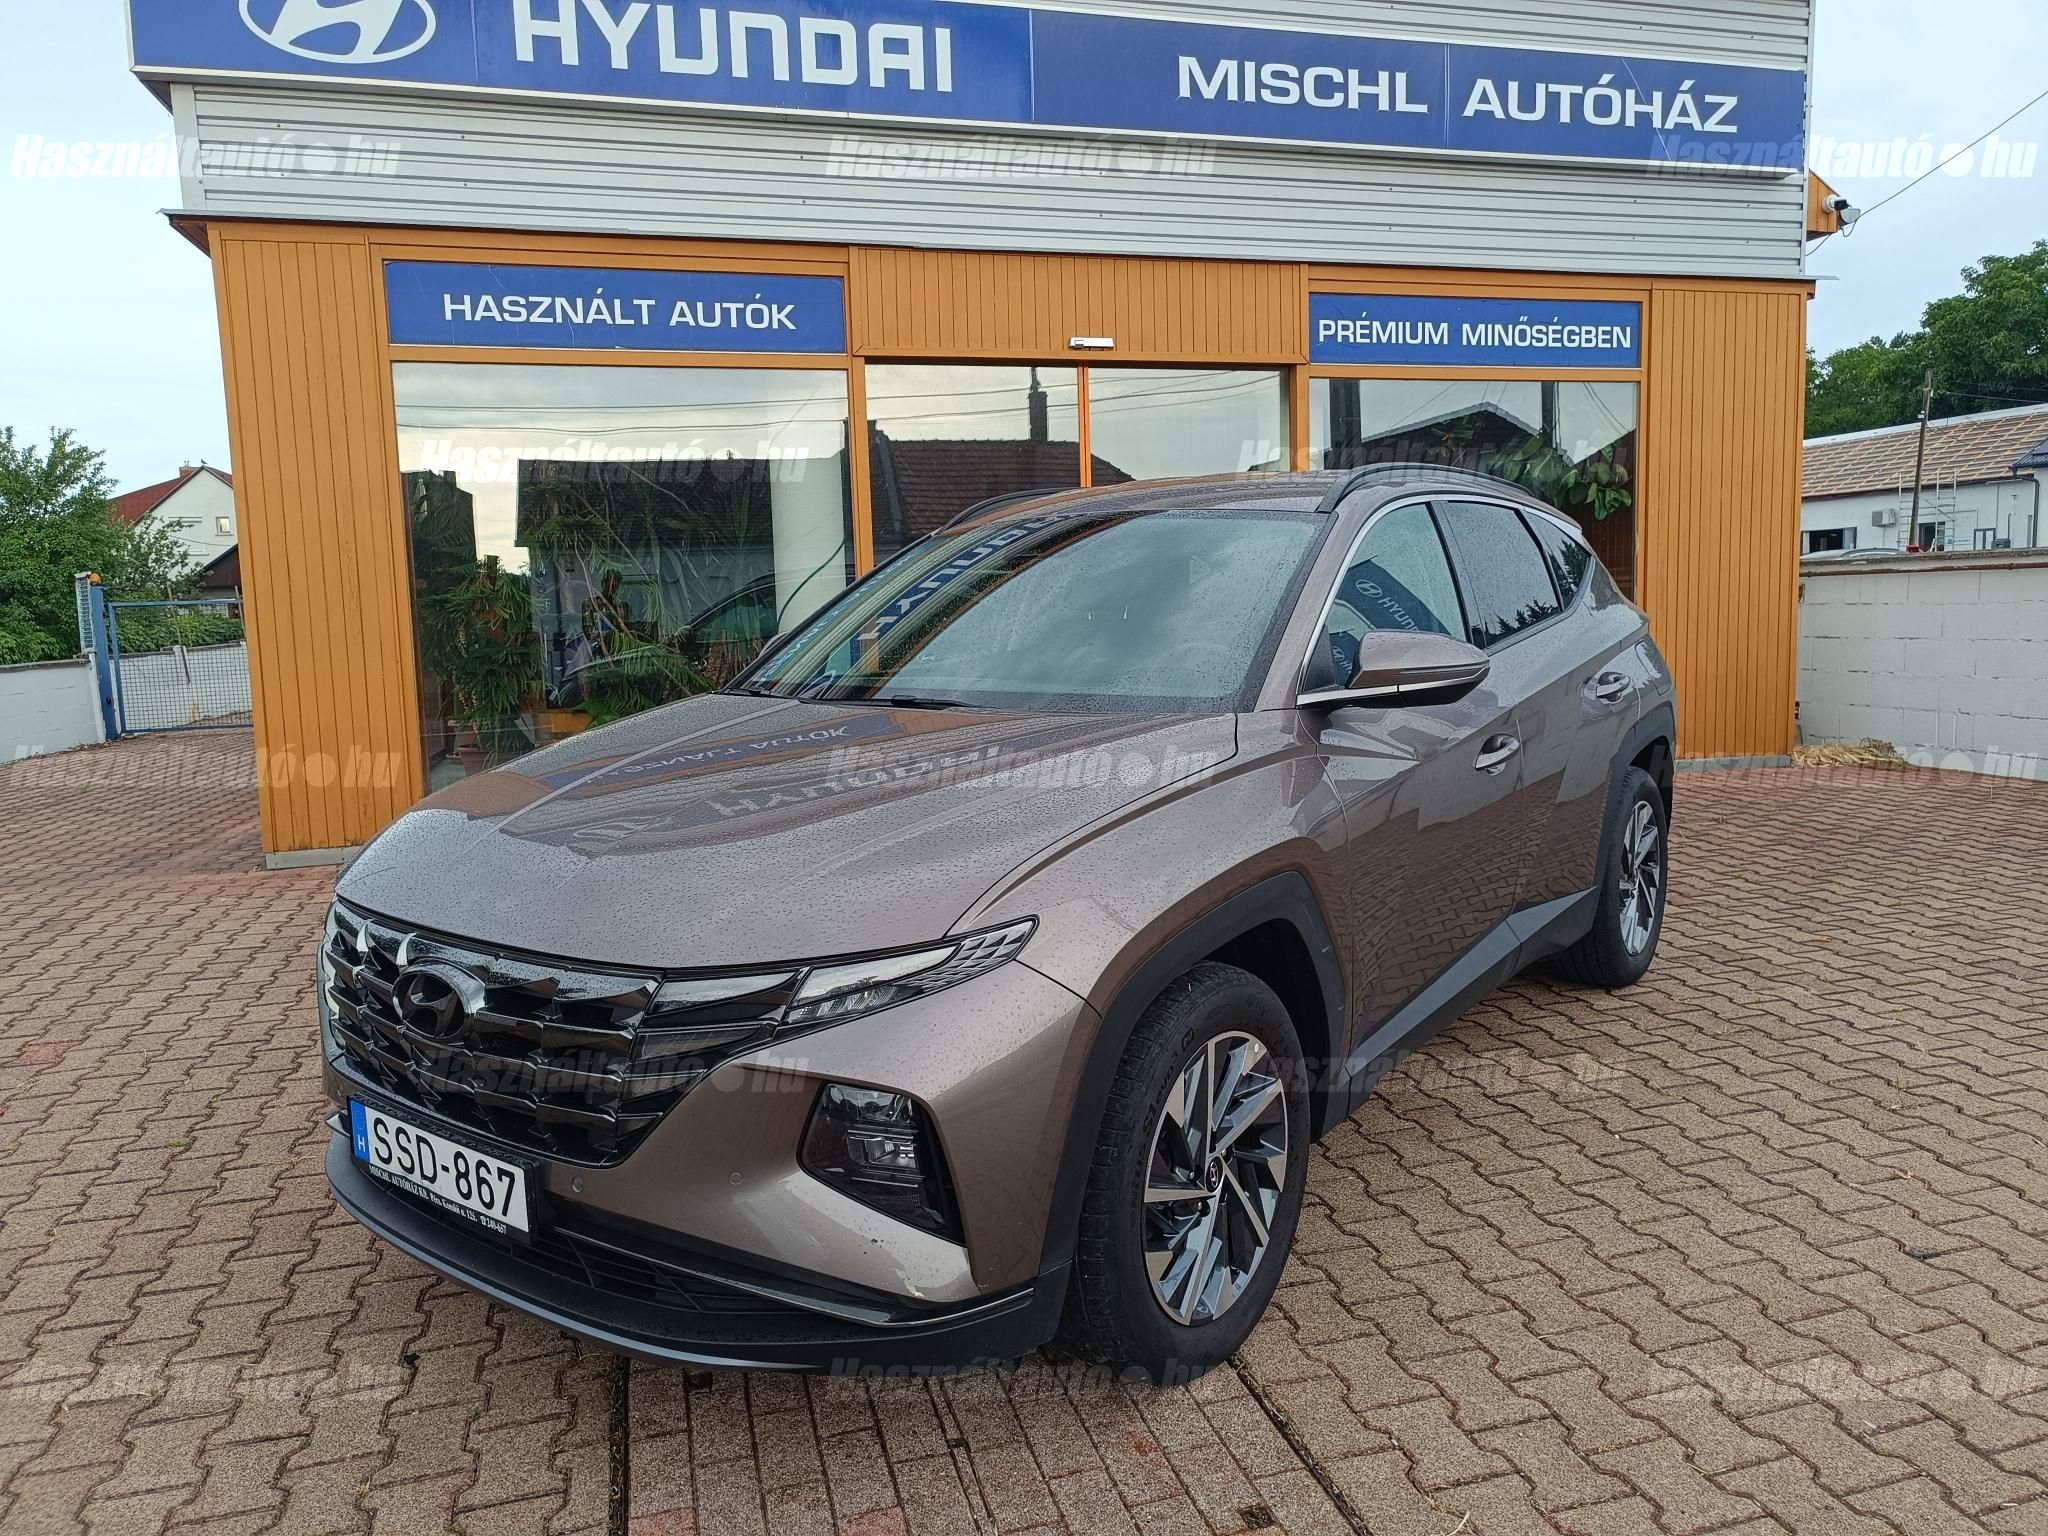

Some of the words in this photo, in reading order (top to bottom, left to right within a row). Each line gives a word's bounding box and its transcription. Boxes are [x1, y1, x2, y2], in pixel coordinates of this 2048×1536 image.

[512, 0, 953, 92] HYUNDAI
[1178, 55, 1428, 113] MISCHL
[1462, 73, 1738, 133] AUTÓHÁZ
[443, 287, 655, 326] HASZNÁLT
[669, 293, 797, 330] AUTÓK
[1318, 312, 1448, 345] PRÉMIUM
[1462, 315, 1631, 348] MINŐSÉGBEN
[357, 1134, 366, 1153] H
[373, 1116, 516, 1217] SSD-867
